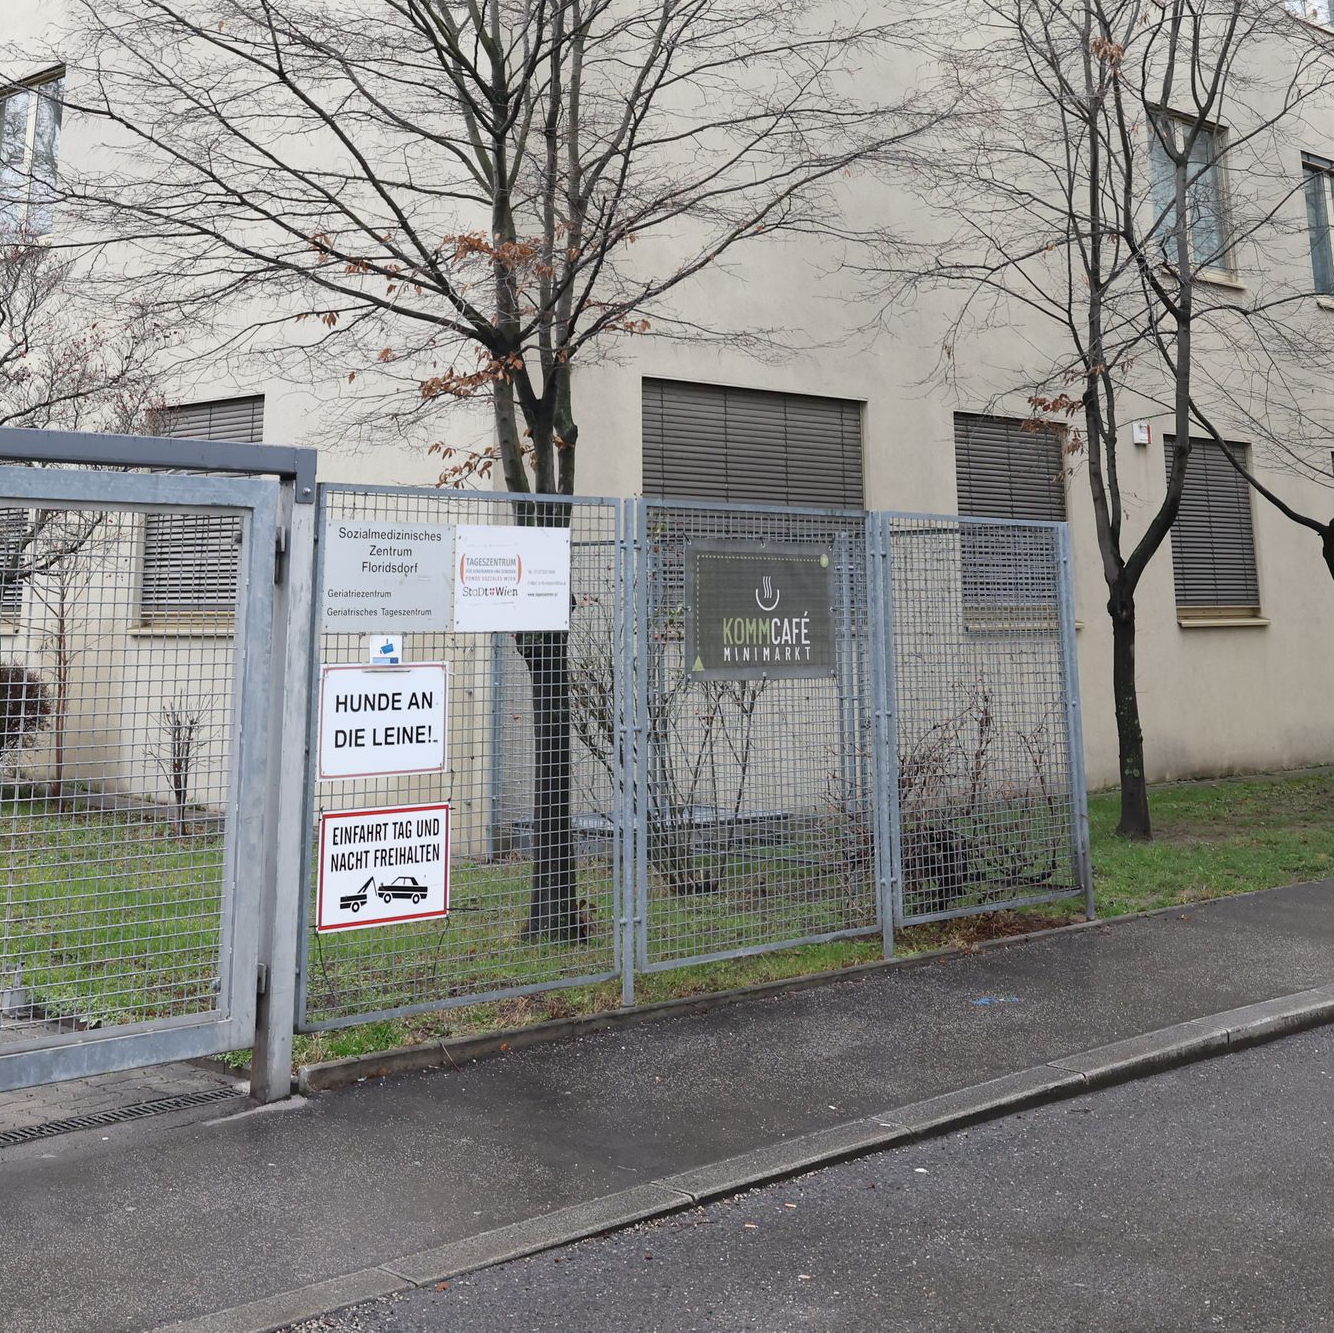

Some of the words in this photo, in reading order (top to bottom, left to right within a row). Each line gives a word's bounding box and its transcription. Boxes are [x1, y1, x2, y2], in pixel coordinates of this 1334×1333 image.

[338, 527, 442, 541] Sozialmedizinisches
[369, 545, 412, 556] Zentrum
[362, 561, 418, 573] Floridsdorf
[466, 558, 516, 566] TAGESZENTRUM
[327, 589, 392, 598] Geriatriezentrum
[496, 586, 518, 596] Wien
[327, 608, 378, 617] Geriatrisches
[381, 608, 432, 617] Tageszentrum
[723, 610, 810, 645] KOMMCAFÉ
[724, 647, 810, 661] MINIMARKT
[336, 692, 402, 713] HUNDE
[407, 691, 433, 710] AN
[335, 728, 365, 748] DIE
[373, 725, 432, 746] LEINE!
[332, 823, 389, 845] EINFAHRT
[392, 820, 412, 840] TAG
[416, 818, 440, 838] UND
[331, 850, 370, 872] NACHT
[374, 843, 440, 868] FREIHALTEN
